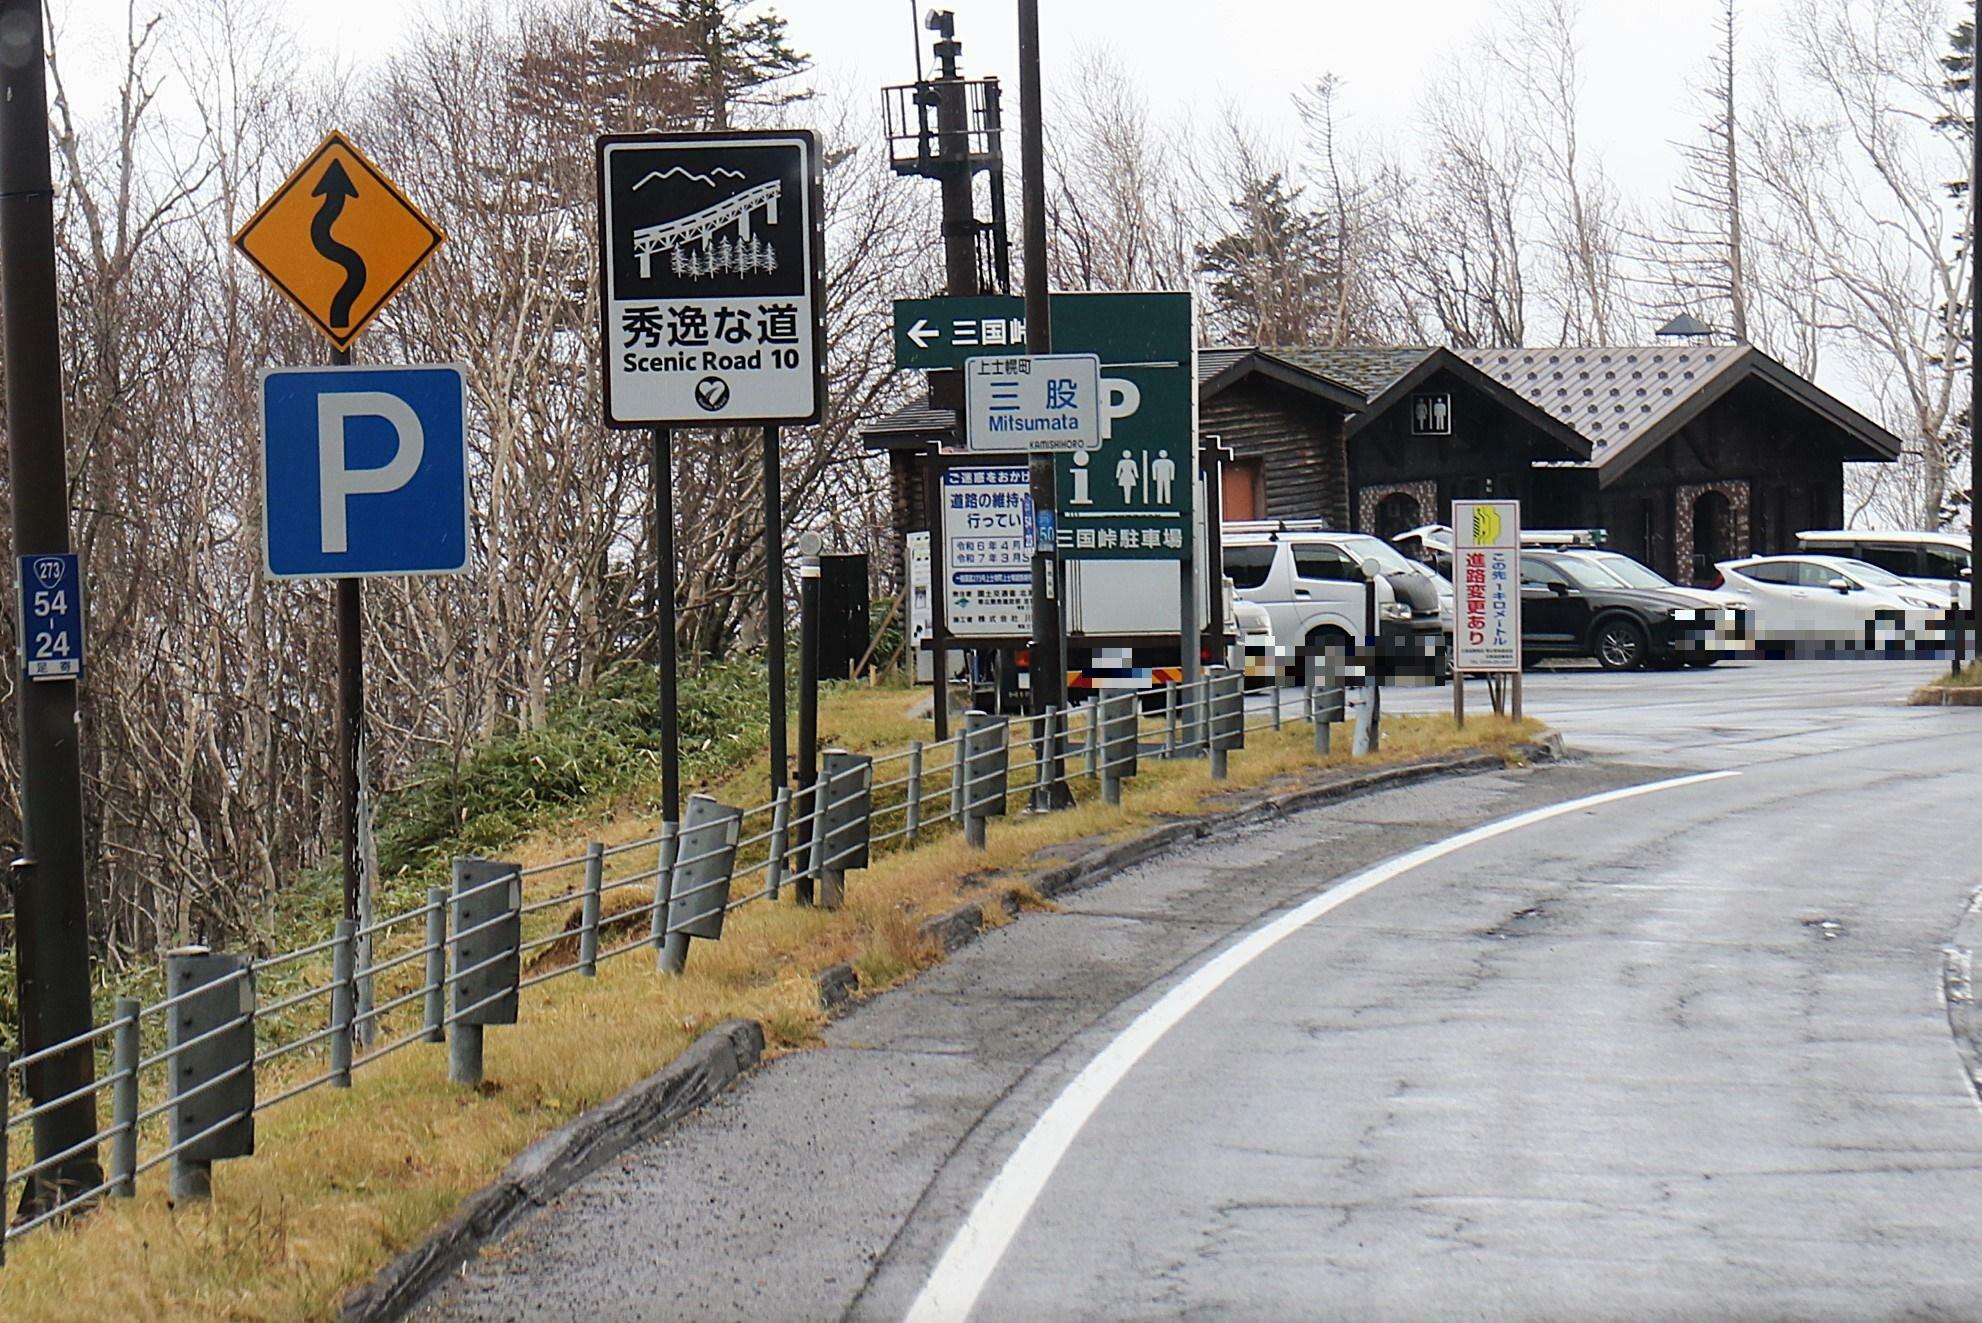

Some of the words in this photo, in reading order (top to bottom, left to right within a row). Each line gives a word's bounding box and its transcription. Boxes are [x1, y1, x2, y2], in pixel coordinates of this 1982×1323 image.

[622, 303, 799, 348] 秀逸な道
[623, 351, 696, 372] Scenic
[702, 350, 761, 371] Road
[771, 349, 799, 370] 10
[977, 358, 1031, 375] 上士幌町
[1100, 378, 1141, 439] P
[989, 413, 1079, 433] Mitsumata
[1029, 439, 1085, 449] KAMISHIHORO
[317, 391, 424, 553] P
[1056, 528, 1183, 548] 三国峠駐車場
[40, 562, 60, 579] 273
[34, 590, 68, 617] 54
[1466, 552, 1487, 646] 進路変更あり
[35, 631, 70, 659] 24
